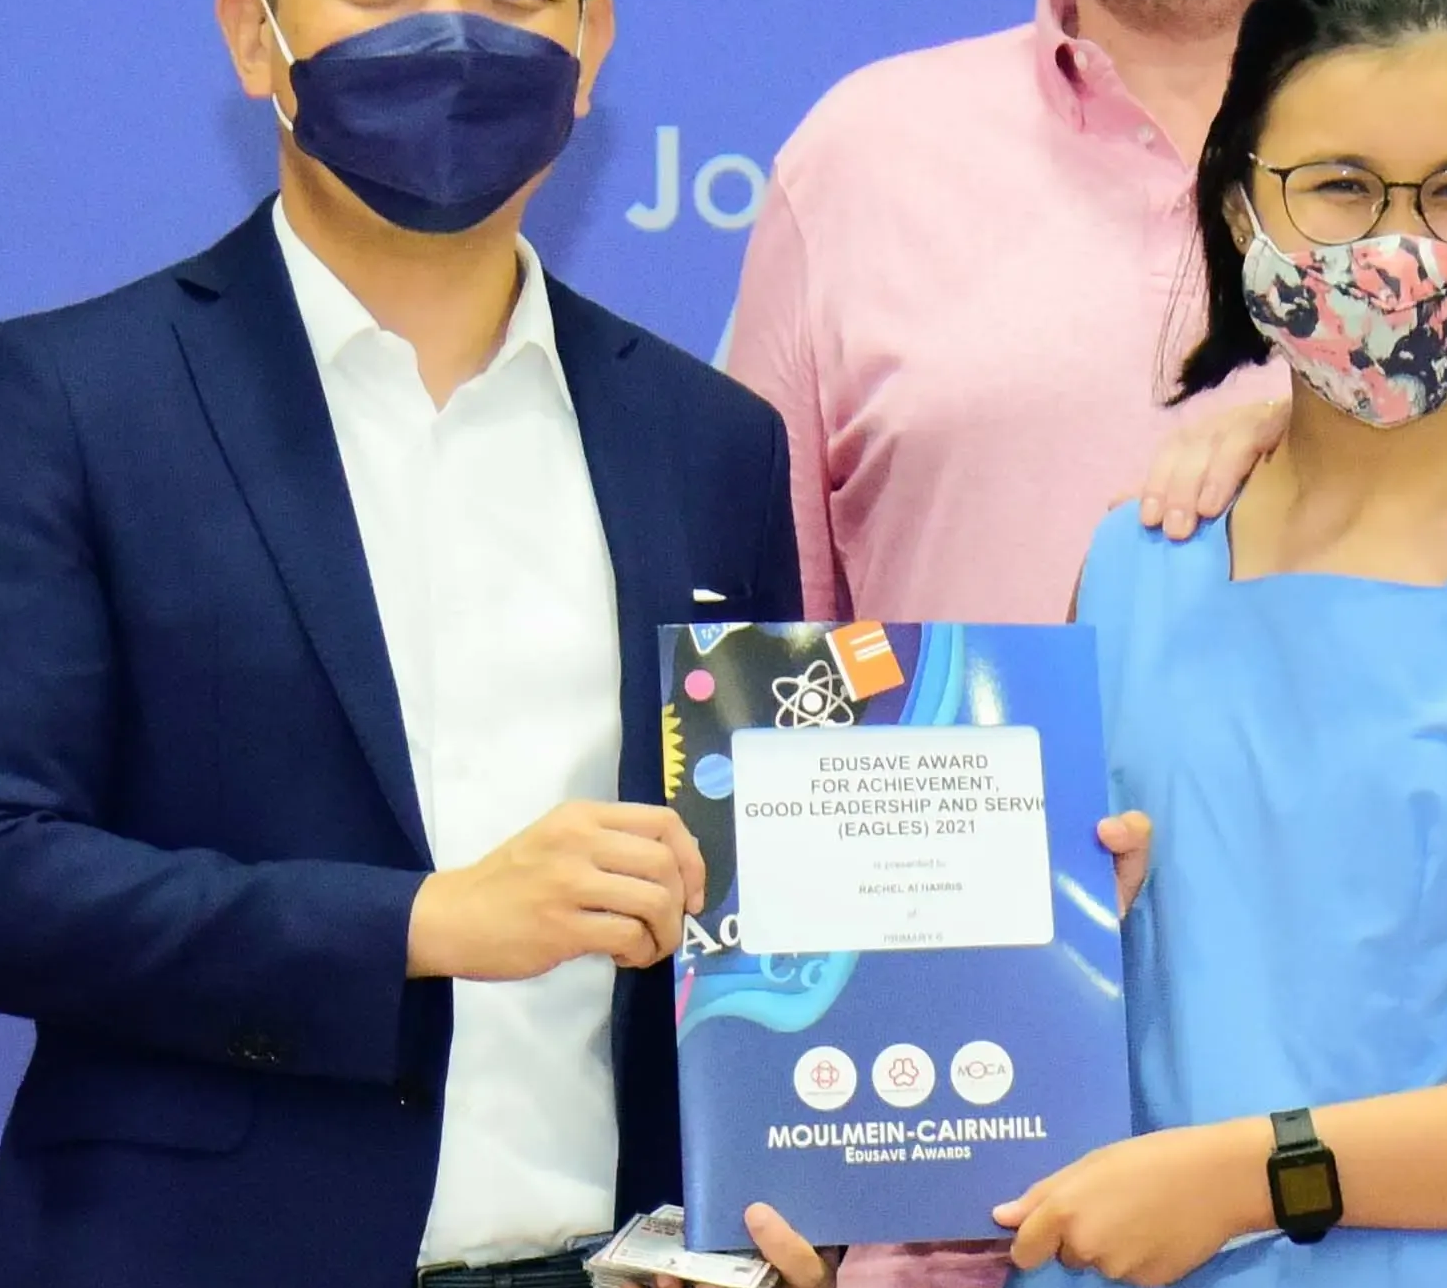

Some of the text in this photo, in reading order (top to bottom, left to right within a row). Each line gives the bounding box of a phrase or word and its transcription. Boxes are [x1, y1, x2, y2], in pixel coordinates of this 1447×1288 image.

[818, 754, 989, 772] EDUSAVE AWARD
[810, 776, 1000, 794] FOR ACHIEVEMENT,
[744, 801, 803, 817] GOOD
[809, 799, 932, 816] LEADERSHIP
[937, 797, 978, 813] AND
[838, 819, 976, 839] (EAGLES) 2021
[767, 1115, 1047, 1149] MOULMEIN-CAIRNHILL
